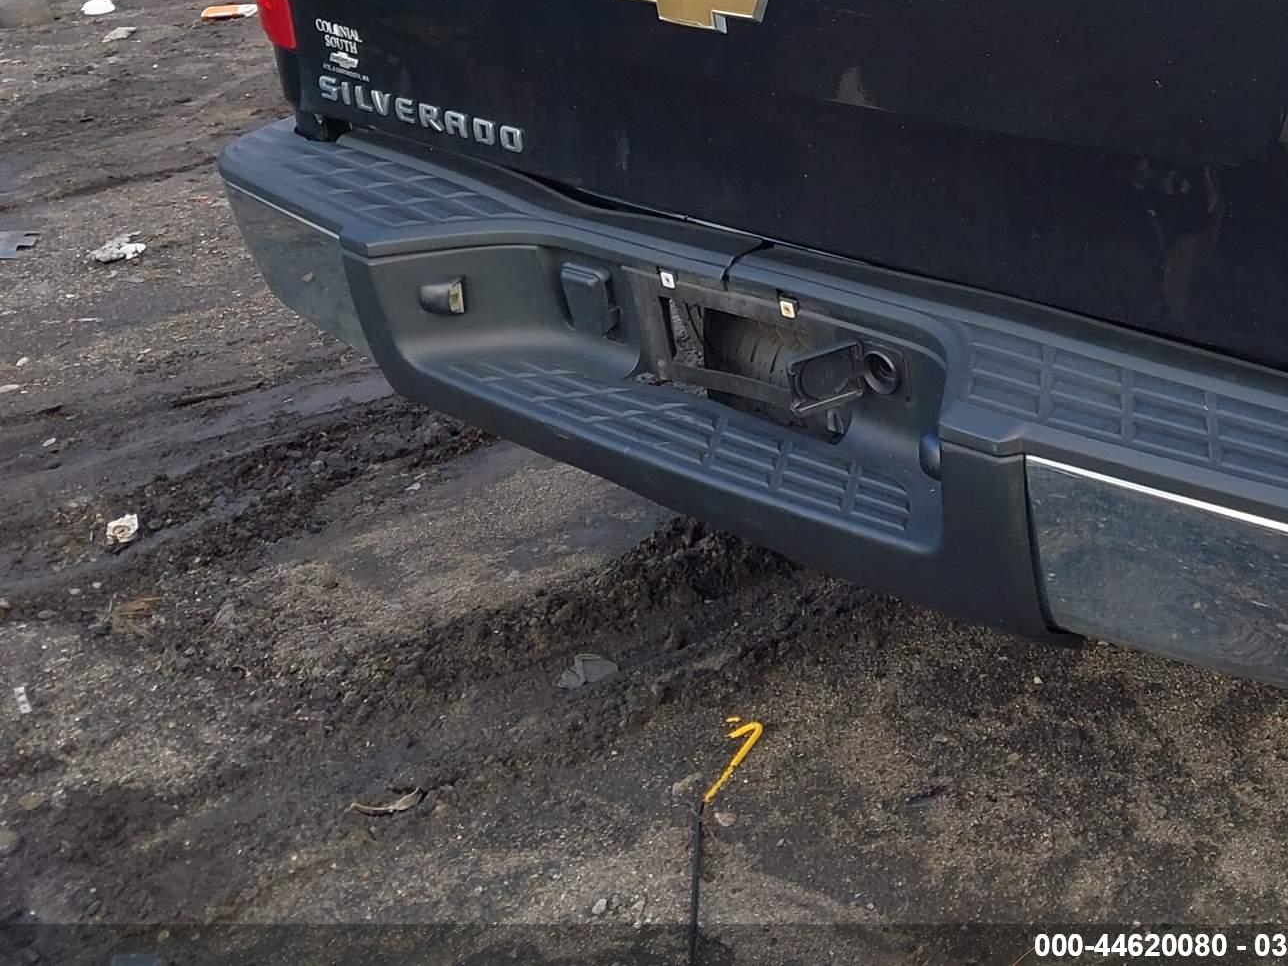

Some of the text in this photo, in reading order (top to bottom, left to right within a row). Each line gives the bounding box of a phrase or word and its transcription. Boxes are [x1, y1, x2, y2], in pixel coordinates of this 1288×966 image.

[315, 18, 363, 43] COLONIAL
[324, 34, 358, 54] SOUTH
[317, 74, 525, 154] SILVERADO
